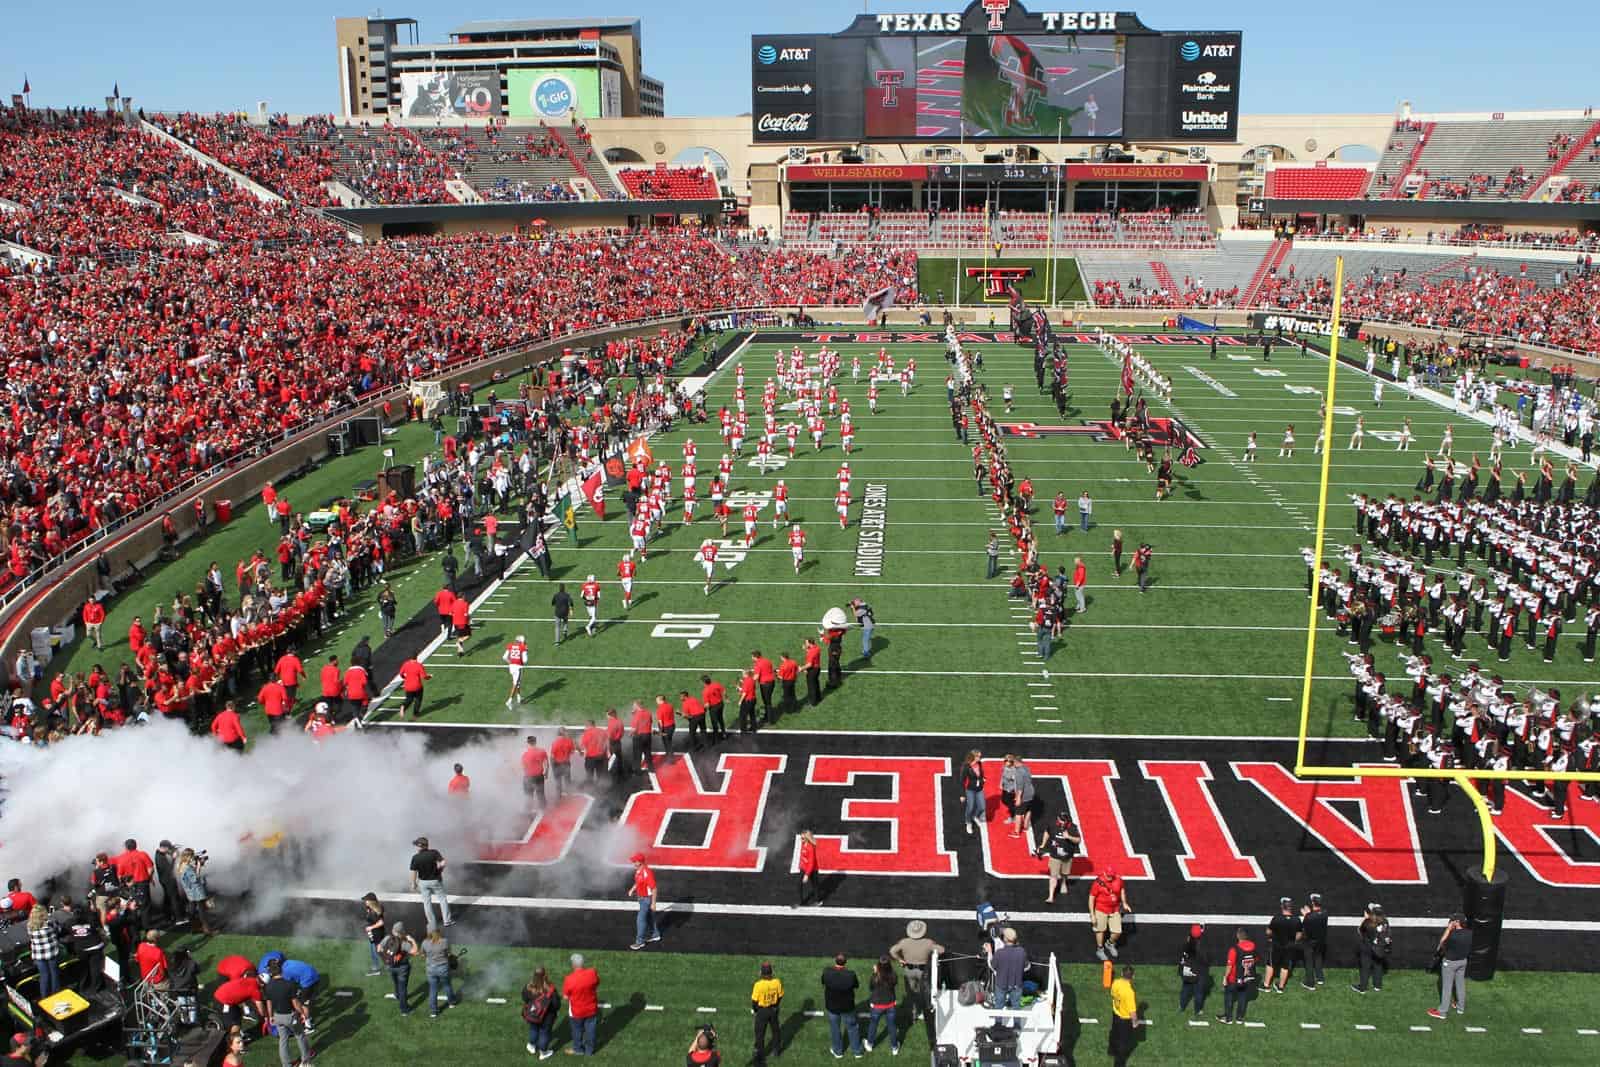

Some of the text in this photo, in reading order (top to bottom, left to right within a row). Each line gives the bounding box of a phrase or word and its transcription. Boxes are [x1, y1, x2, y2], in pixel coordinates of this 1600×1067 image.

[877, 13, 962, 31] TEXAS
[1042, 12, 1117, 30] TECH
[779, 48, 811, 60] AT&T
[1203, 45, 1236, 57] AT&T
[454, 87, 493, 113] 40
[1182, 111, 1228, 123] United
[864, 484, 888, 508] JONES
[854, 530, 884, 576] STADIUM
